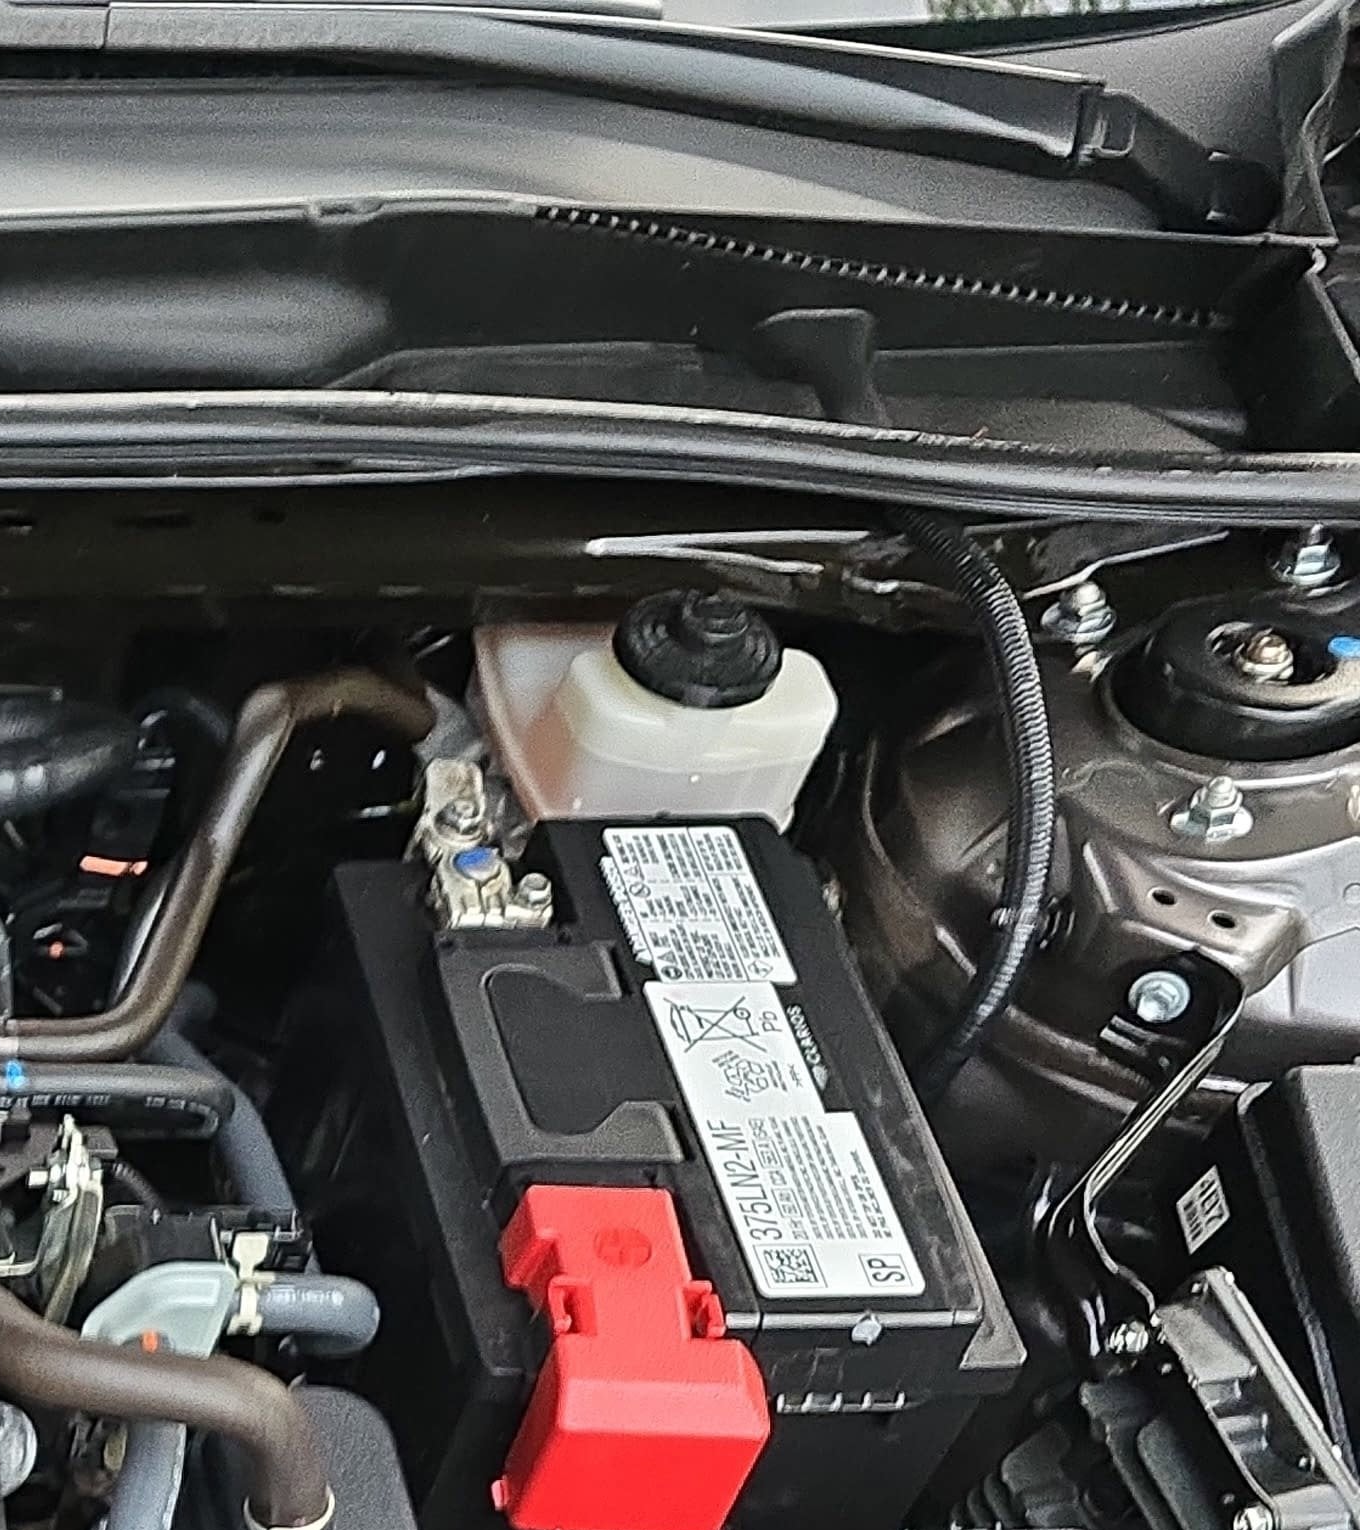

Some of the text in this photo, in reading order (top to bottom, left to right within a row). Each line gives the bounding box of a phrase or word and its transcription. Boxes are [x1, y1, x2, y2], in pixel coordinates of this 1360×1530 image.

[761, 1010, 783, 1033] Pb
[786, 1004, 821, 1066] CLARIOS
[706, 1119, 783, 1241] 375LN2-MF
[866, 1257, 907, 1283] SP
